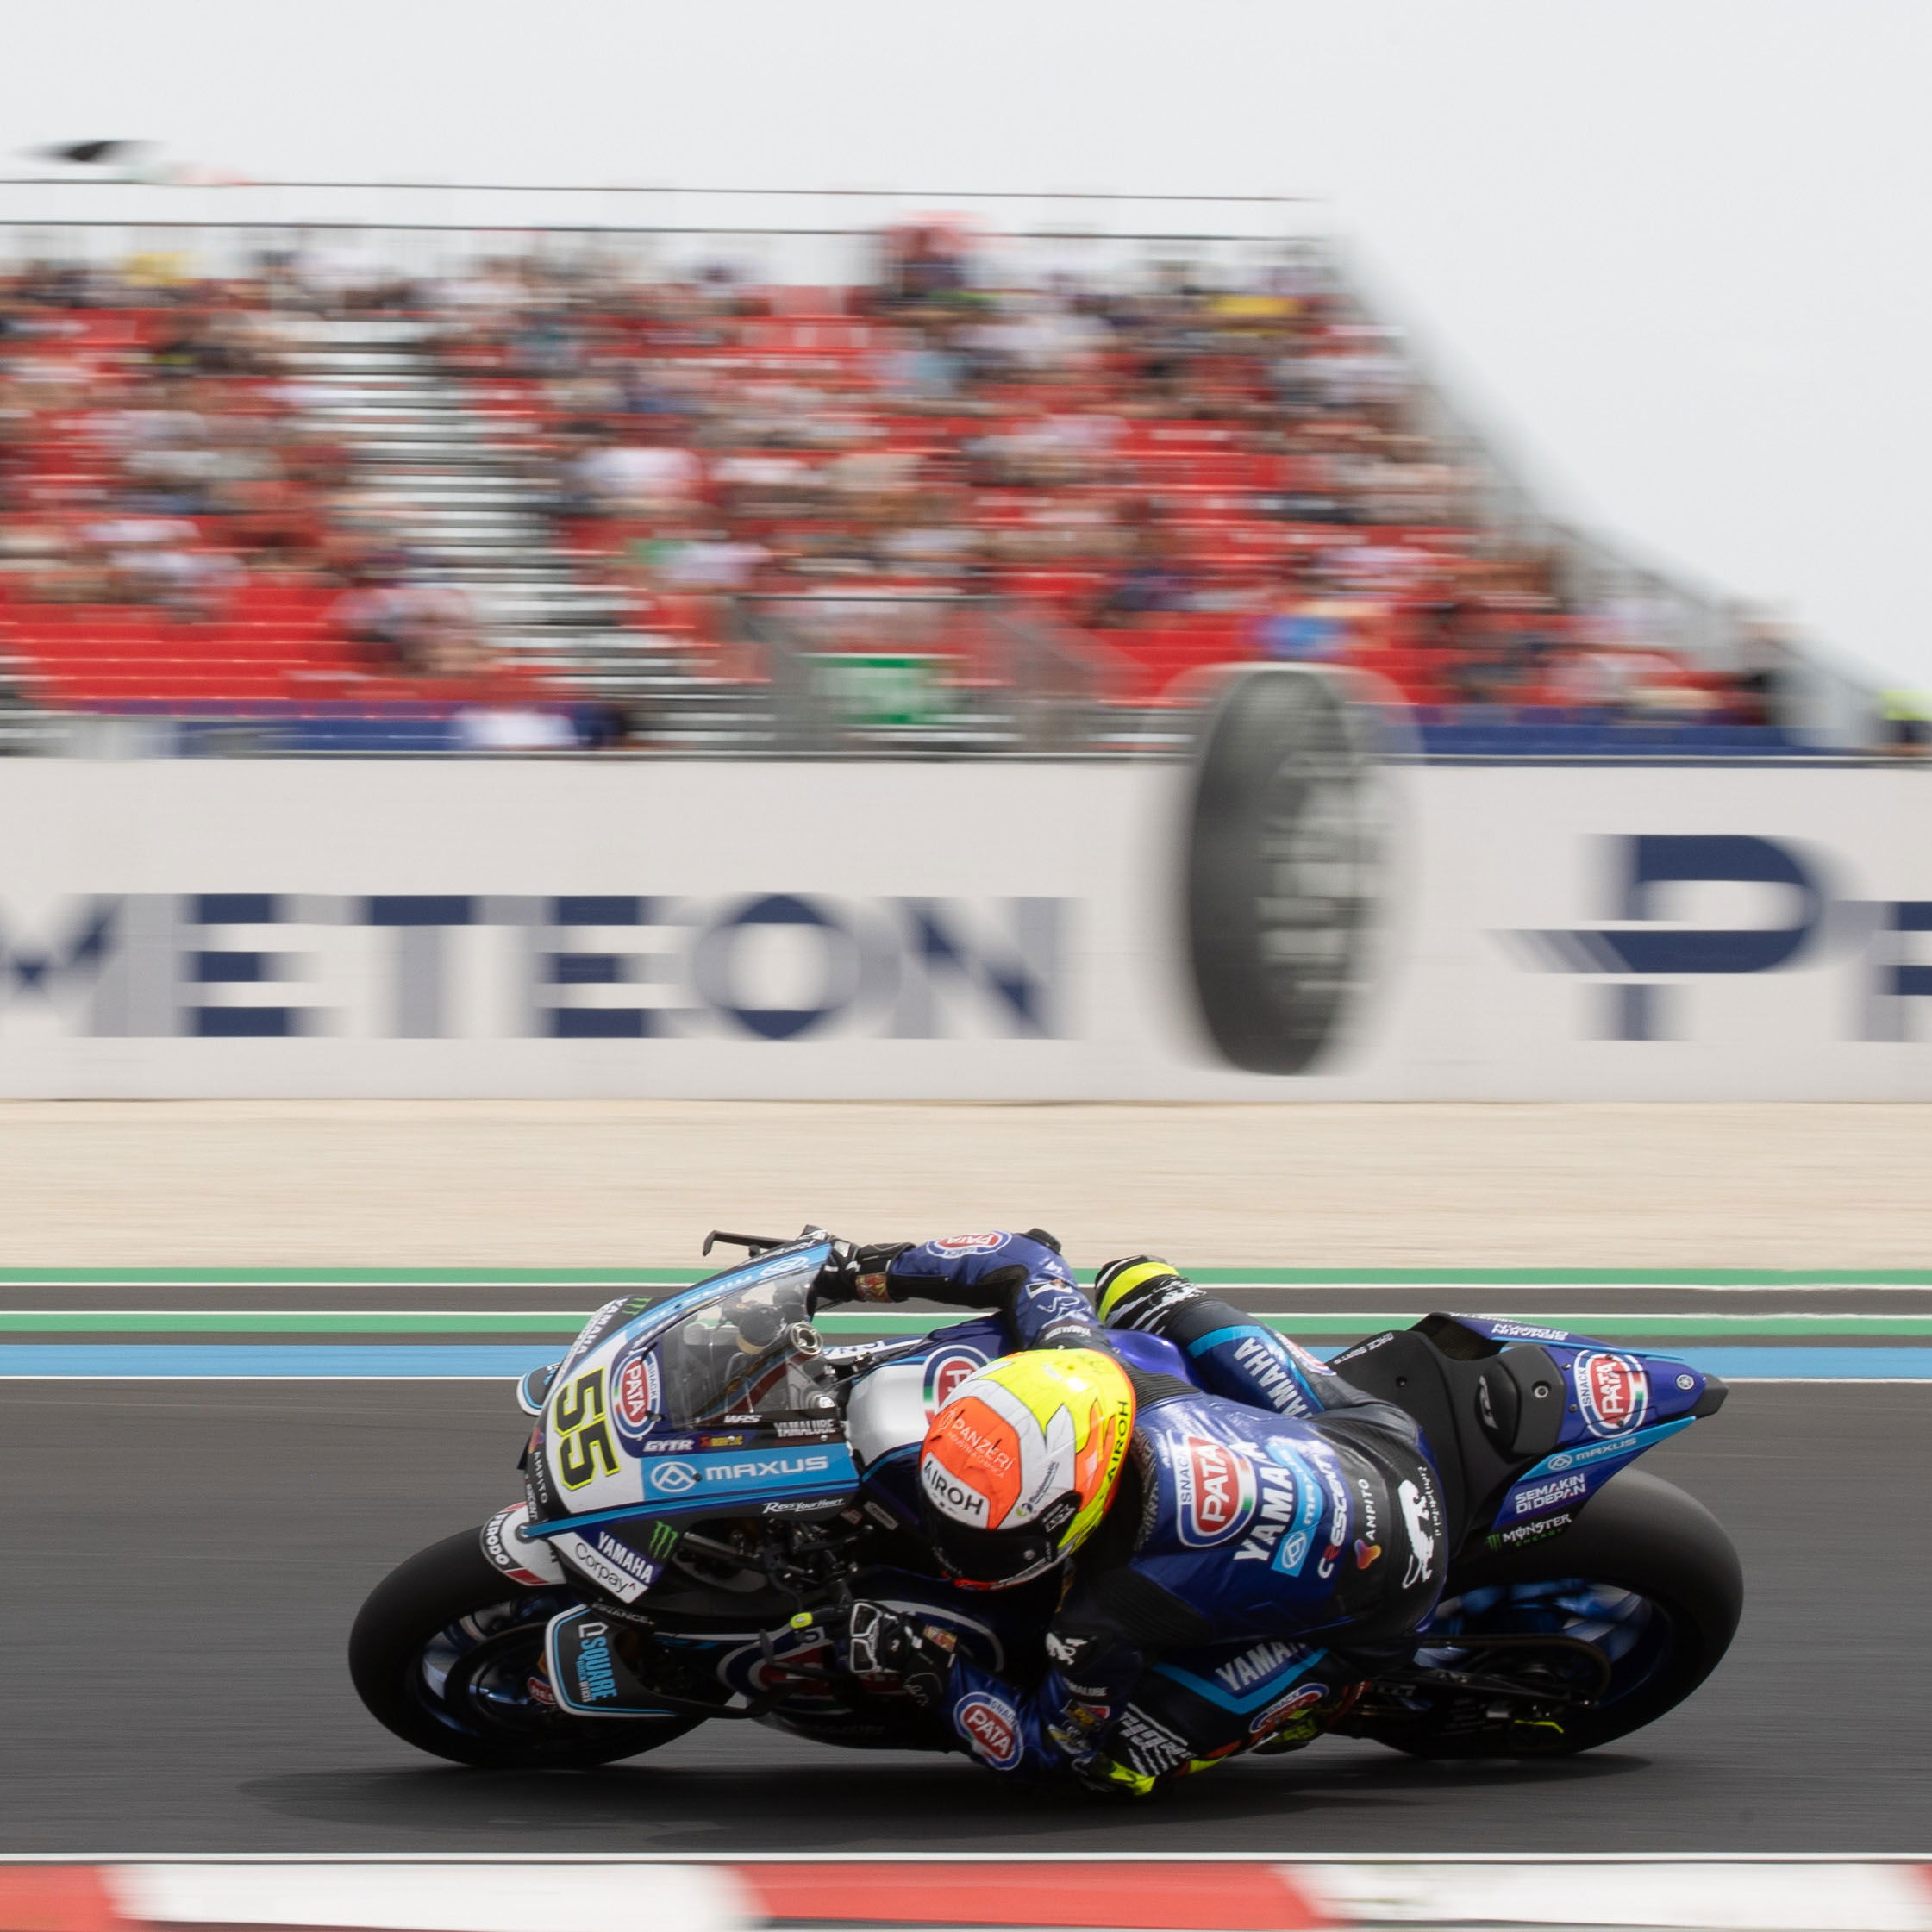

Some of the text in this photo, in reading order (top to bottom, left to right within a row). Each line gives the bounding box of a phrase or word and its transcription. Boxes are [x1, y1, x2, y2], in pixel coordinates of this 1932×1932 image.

[627, 1365, 645, 1417] PATA
[1234, 1337, 1313, 1419] AMAHA
[1579, 1368, 1591, 1406] SNACK
[1596, 1361, 1624, 1414] PATA
[553, 1366, 621, 1492] 55
[643, 1439, 694, 1453] GYTR
[774, 1419, 837, 1438] YAMALUBE
[952, 1416, 1016, 1472] PANZERI
[1107, 1399, 1129, 1483] AIROH
[1575, 1437, 1638, 1461] MAXUS
[706, 1456, 828, 1481] MAXUS
[923, 1460, 985, 1516] AIROH
[1197, 1444, 1231, 1522] PATA
[1358, 1478, 1378, 1532] AMPITO
[1533, 1484, 1586, 1510] DEPAN
[485, 1513, 510, 1566] FERODO
[597, 1530, 655, 1585] YAMAHA
[575, 1541, 630, 1593] Corpay
[578, 1635, 619, 1701] SQUARE
[1215, 1641, 1307, 1691] YAMA
[966, 1708, 1013, 1755] PATA
